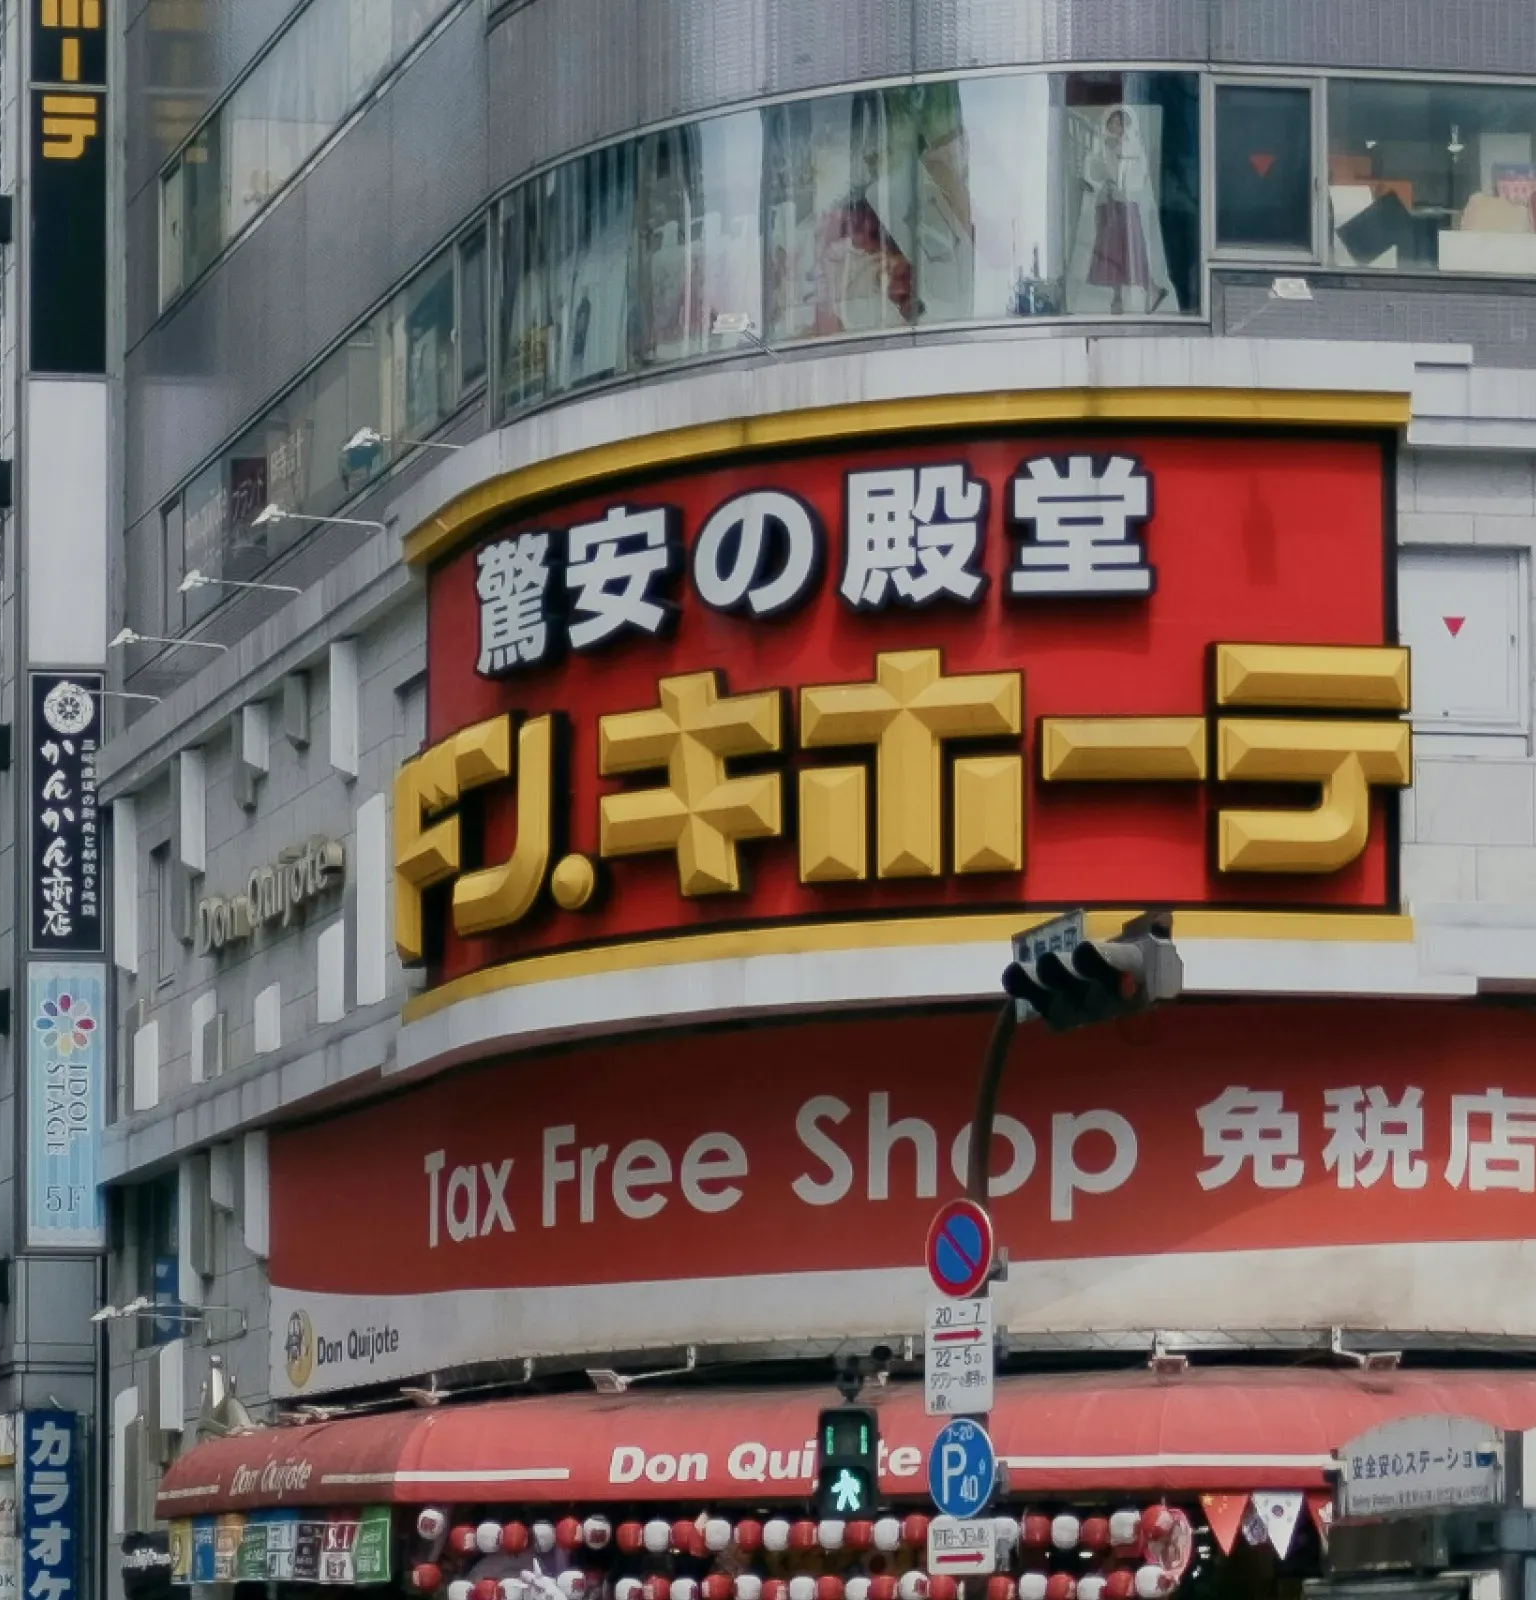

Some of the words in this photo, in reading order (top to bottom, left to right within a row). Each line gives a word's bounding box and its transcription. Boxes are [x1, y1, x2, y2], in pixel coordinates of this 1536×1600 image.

[474, 454, 1154, 676] 驚安の殿堂
[46, 1062, 66, 1156] STAGE
[68, 1064, 89, 1139] IDOL
[423, 1147, 517, 1249] Tax
[542, 1123, 750, 1228] Free
[792, 1089, 1139, 1223] Shop
[317, 1334, 344, 1366] Don
[347, 1325, 400, 1362] Quijote
[608, 1445, 709, 1485] Don
[943, 1442, 967, 1504] P
